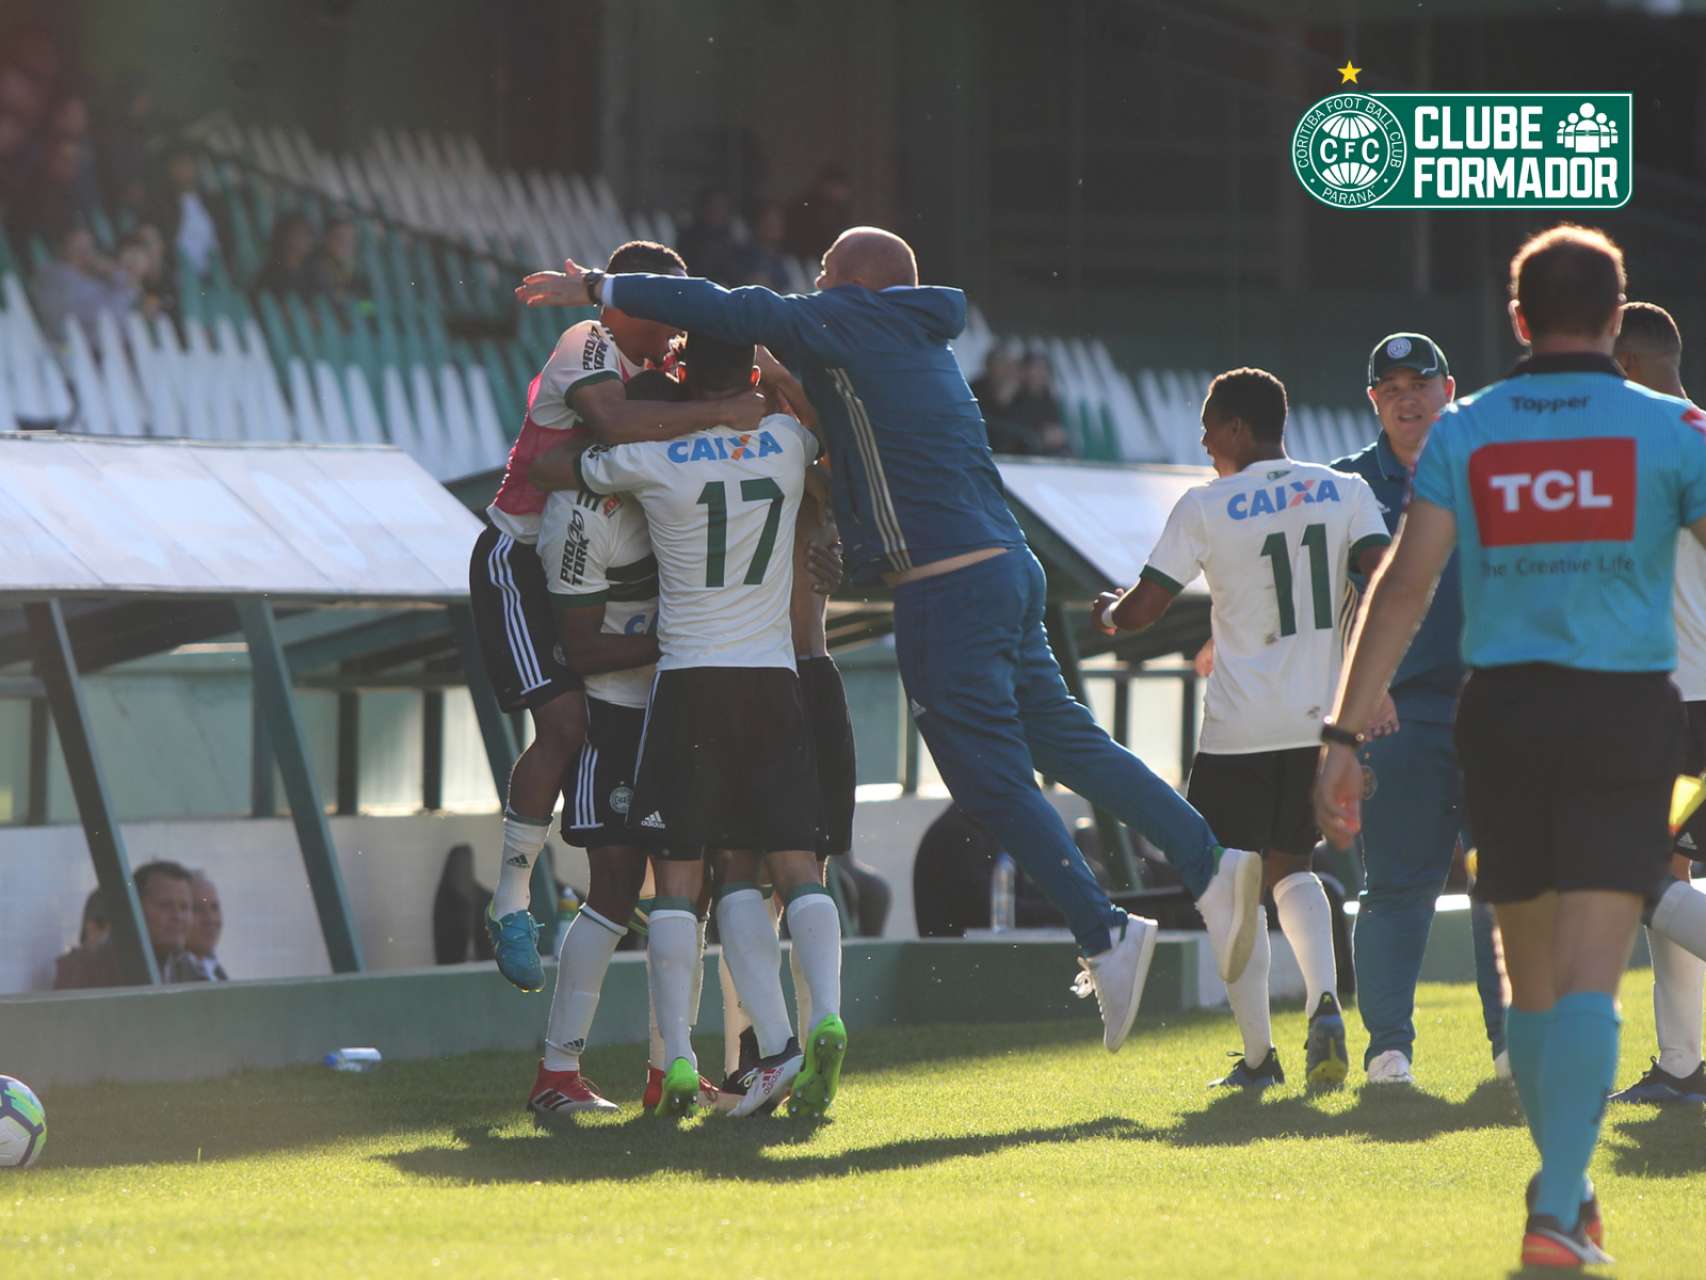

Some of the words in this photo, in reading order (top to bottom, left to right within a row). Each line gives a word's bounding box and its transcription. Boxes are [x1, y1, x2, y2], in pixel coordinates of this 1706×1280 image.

[1510, 395, 1591, 414] Topper
[667, 431, 784, 464] CAIXA
[1226, 479, 1340, 521] CAIXA
[1489, 470, 1613, 512] TCL
[696, 478, 785, 588] 17
[559, 539, 576, 584] PRO
[571, 535, 591, 586] TORK
[1260, 523, 1333, 637] 11
